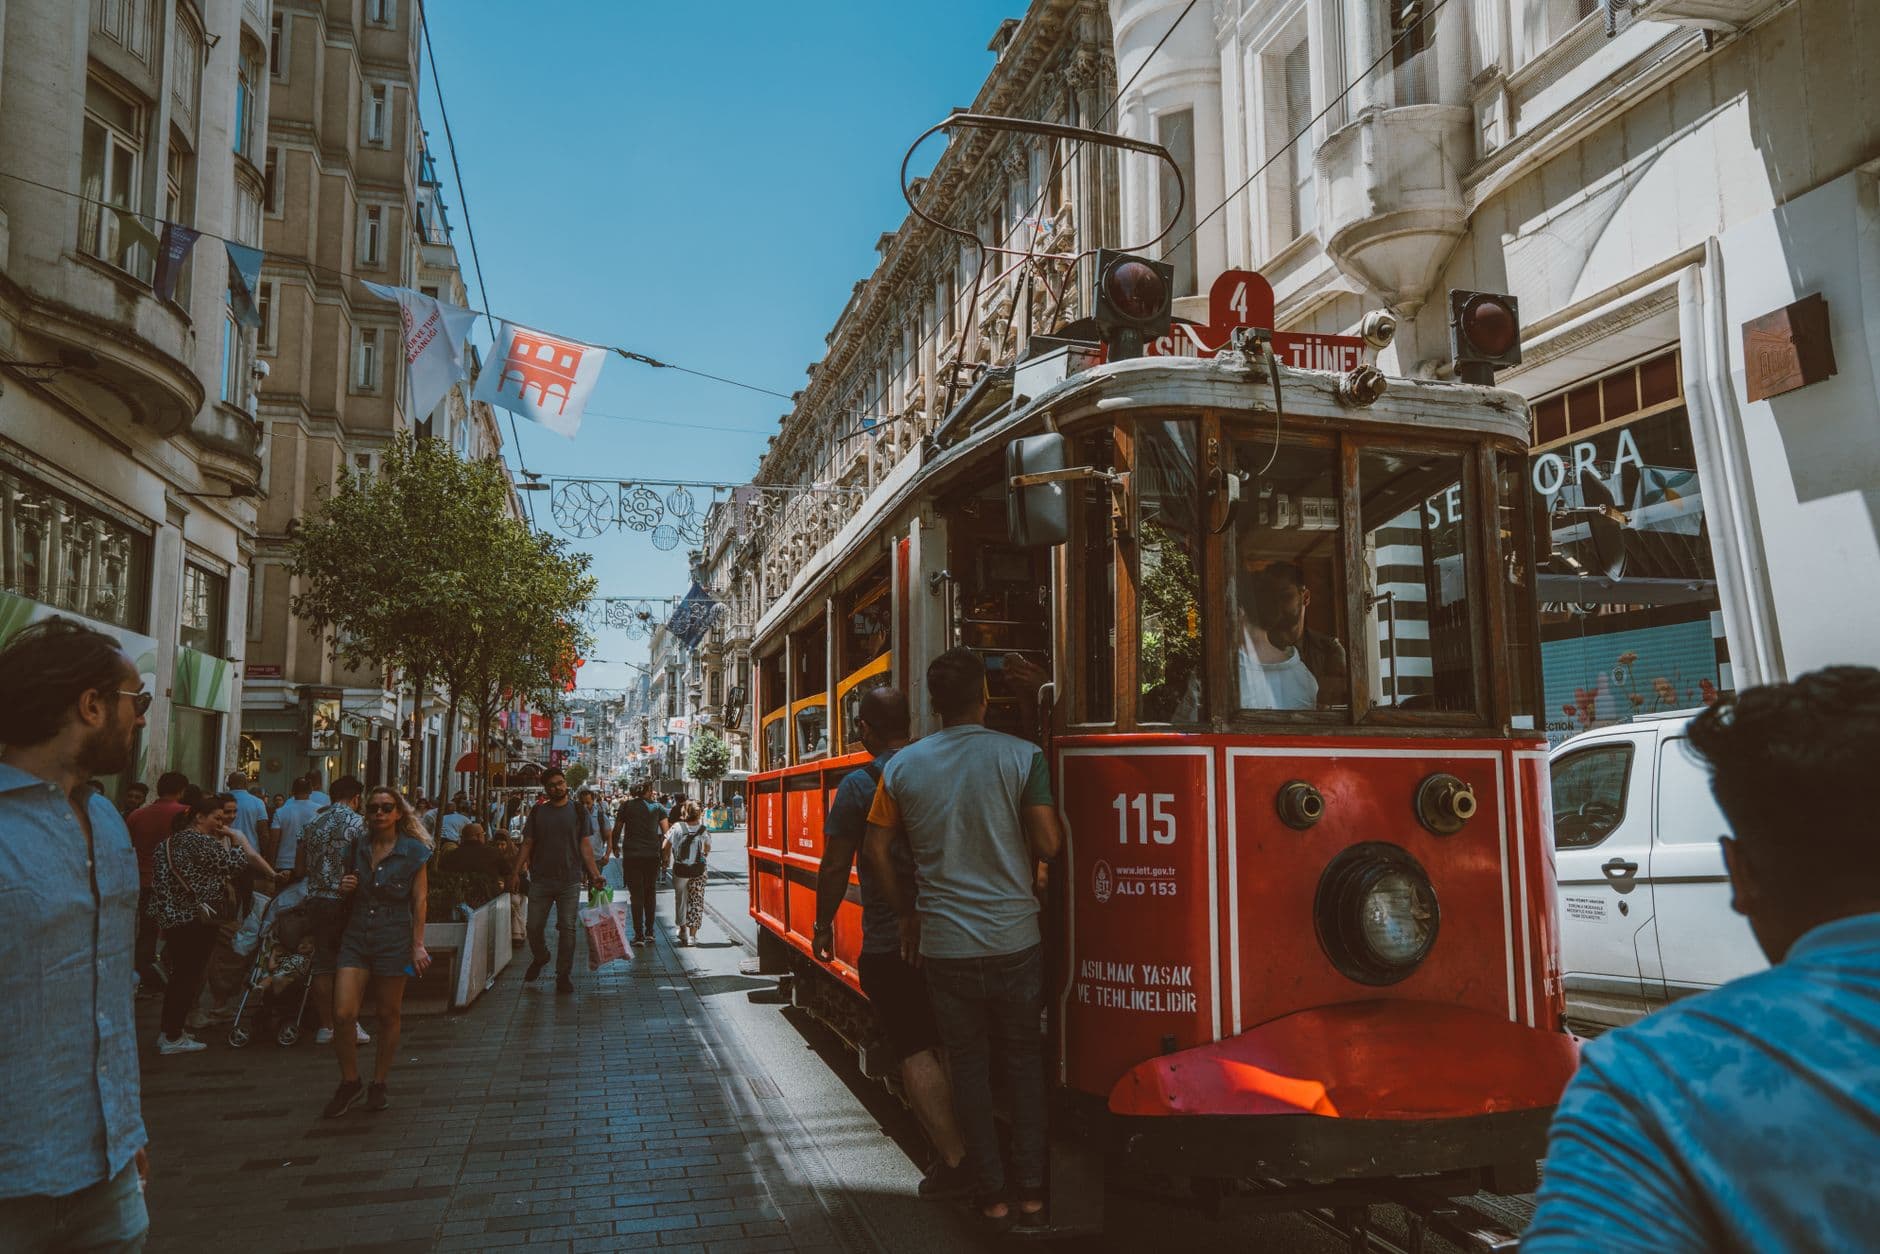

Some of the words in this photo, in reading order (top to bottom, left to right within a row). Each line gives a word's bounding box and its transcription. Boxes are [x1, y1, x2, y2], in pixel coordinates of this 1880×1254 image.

[1230, 281, 1248, 323] 4
[415, 328, 426, 339] VE
[1143, 329, 1197, 357] SİM
[1112, 793, 1176, 845] 115
[1116, 865, 1176, 876] www.iett.gov.tr
[1116, 881, 1146, 895] ALO
[1150, 882, 1177, 896] 153
[1081, 960, 1135, 984] ASILMAK
[1142, 965, 1192, 986] YASAK
[1077, 983, 1091, 1004] VE
[1096, 987, 1197, 1013] TEHLİKELİDİR
